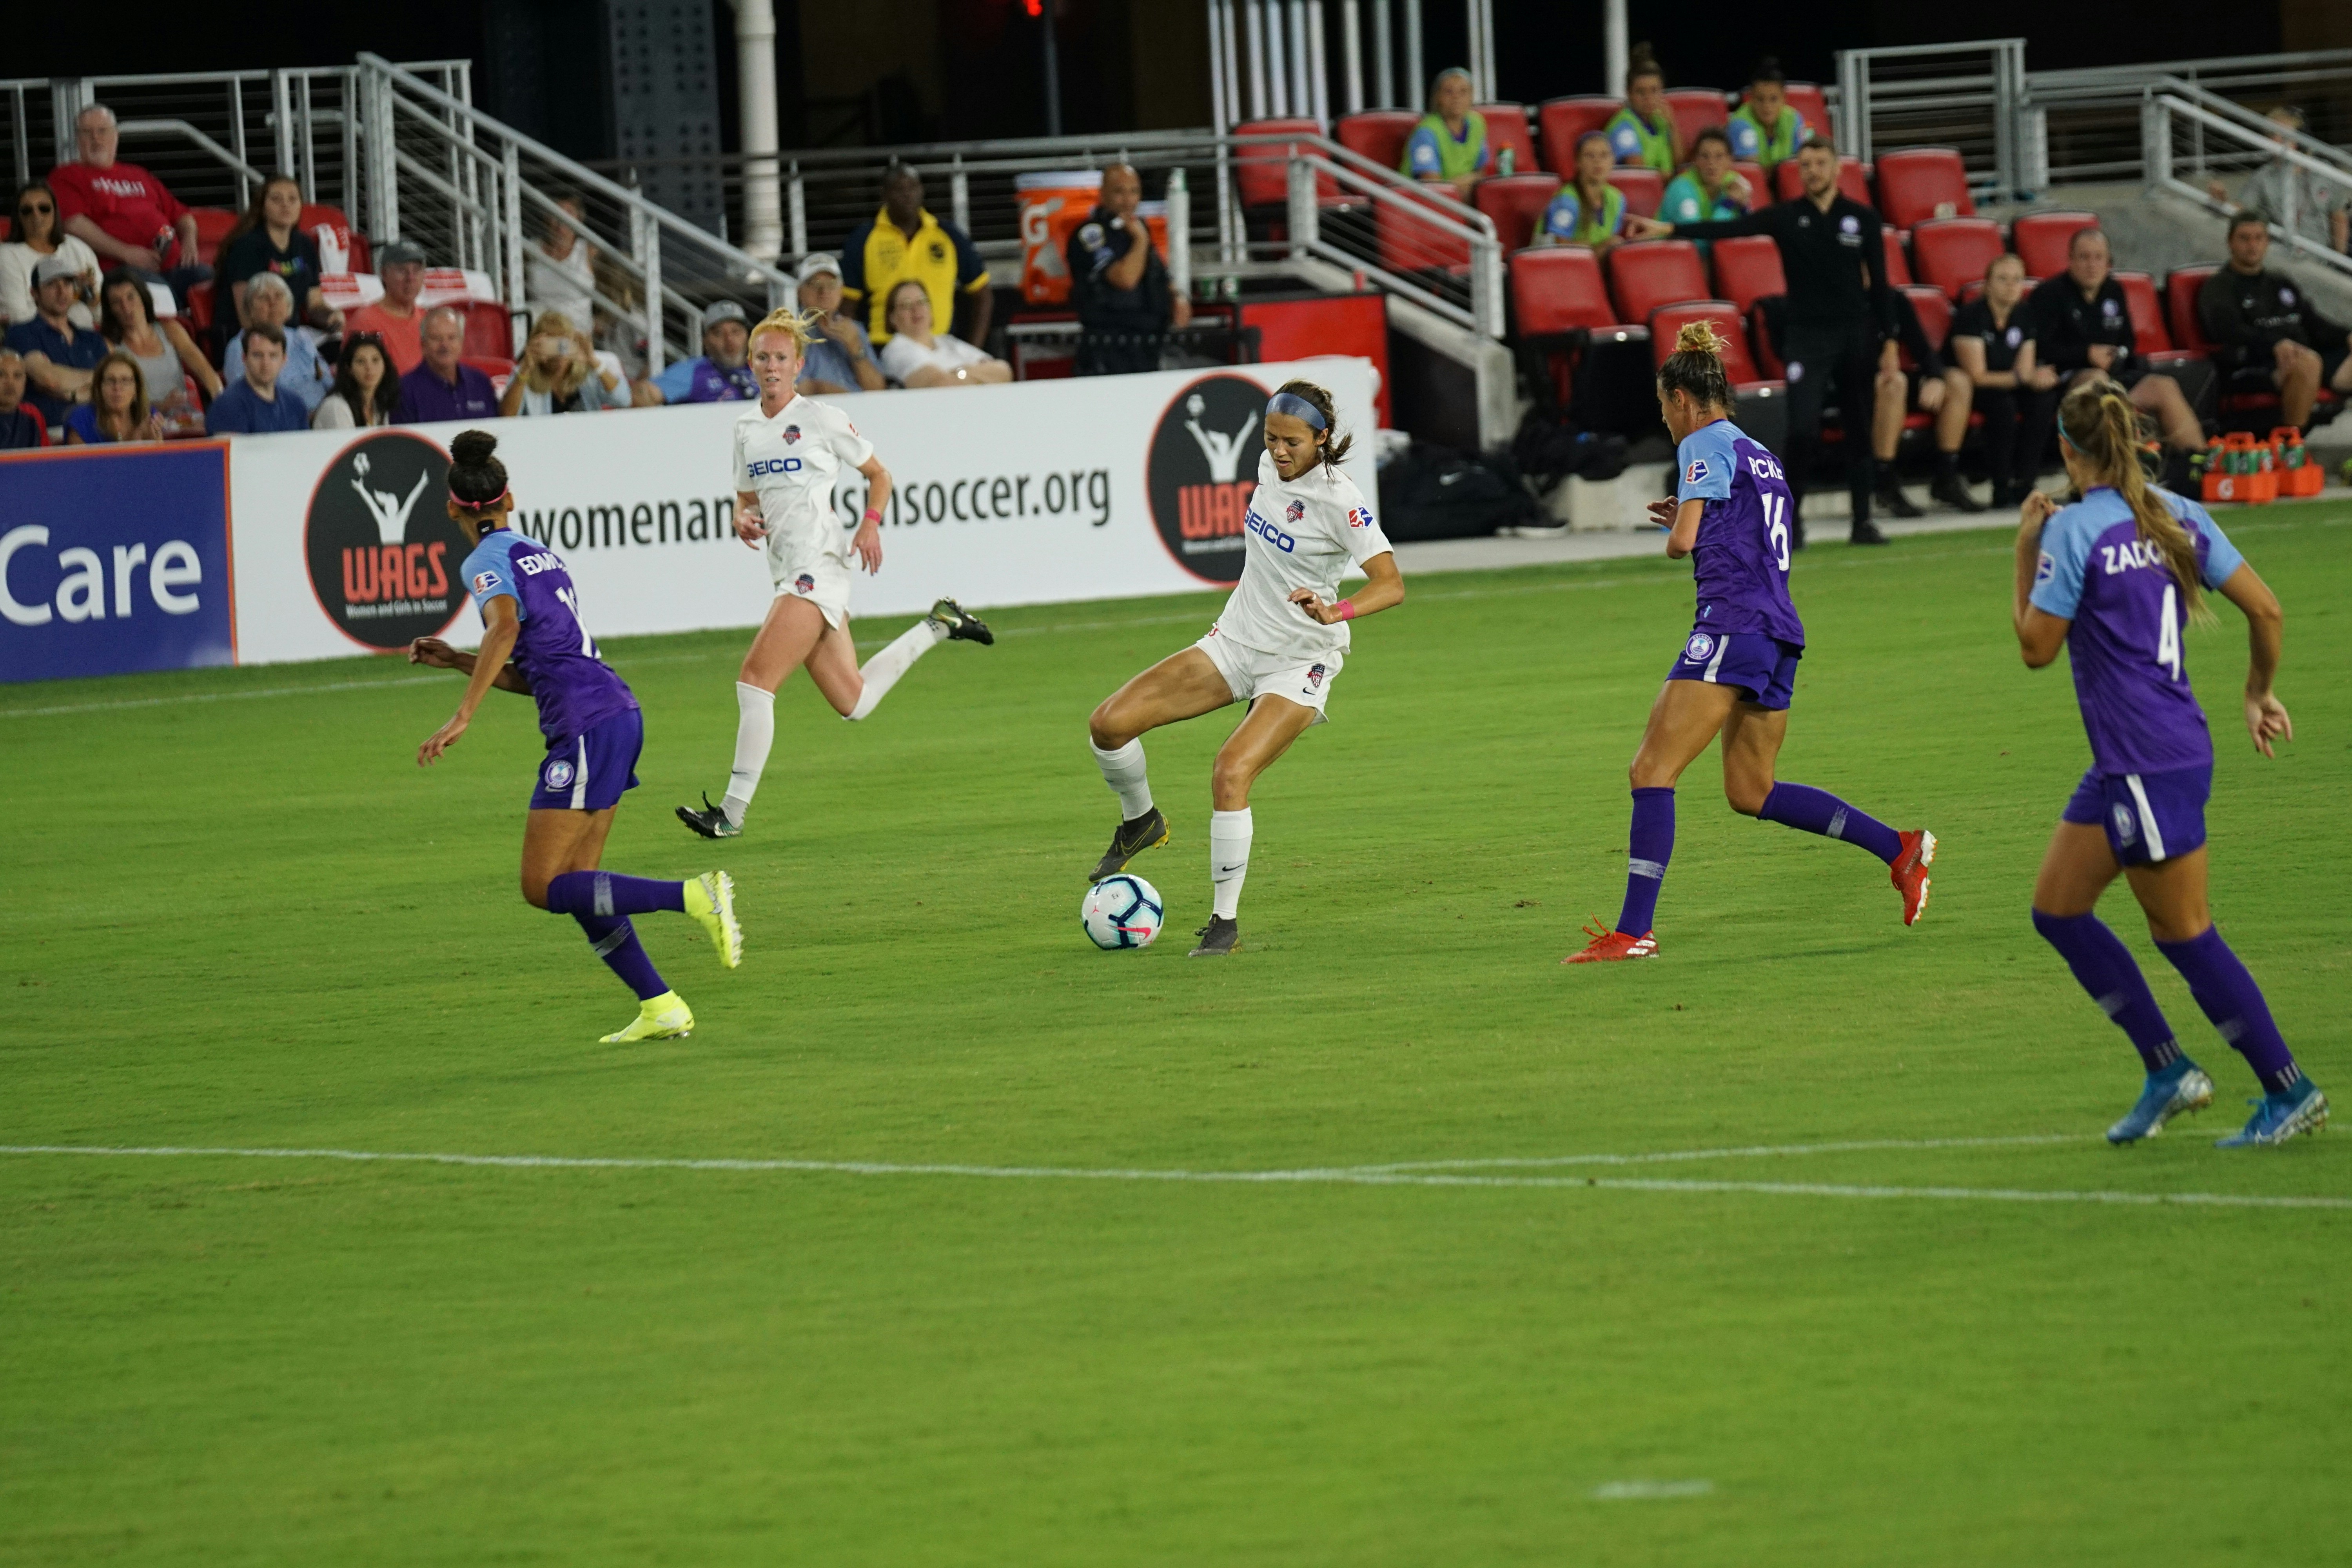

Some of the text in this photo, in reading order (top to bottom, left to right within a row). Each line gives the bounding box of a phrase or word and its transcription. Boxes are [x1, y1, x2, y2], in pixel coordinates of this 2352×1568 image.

[1761, 492, 1789, 571] 16
[0, 524, 202, 626] Care
[342, 541, 449, 604] WAGS
[345, 603, 377, 619] Women
[377, 601, 394, 618] and
[393, 599, 412, 617] Girls
[2158, 584, 2180, 682] 4
